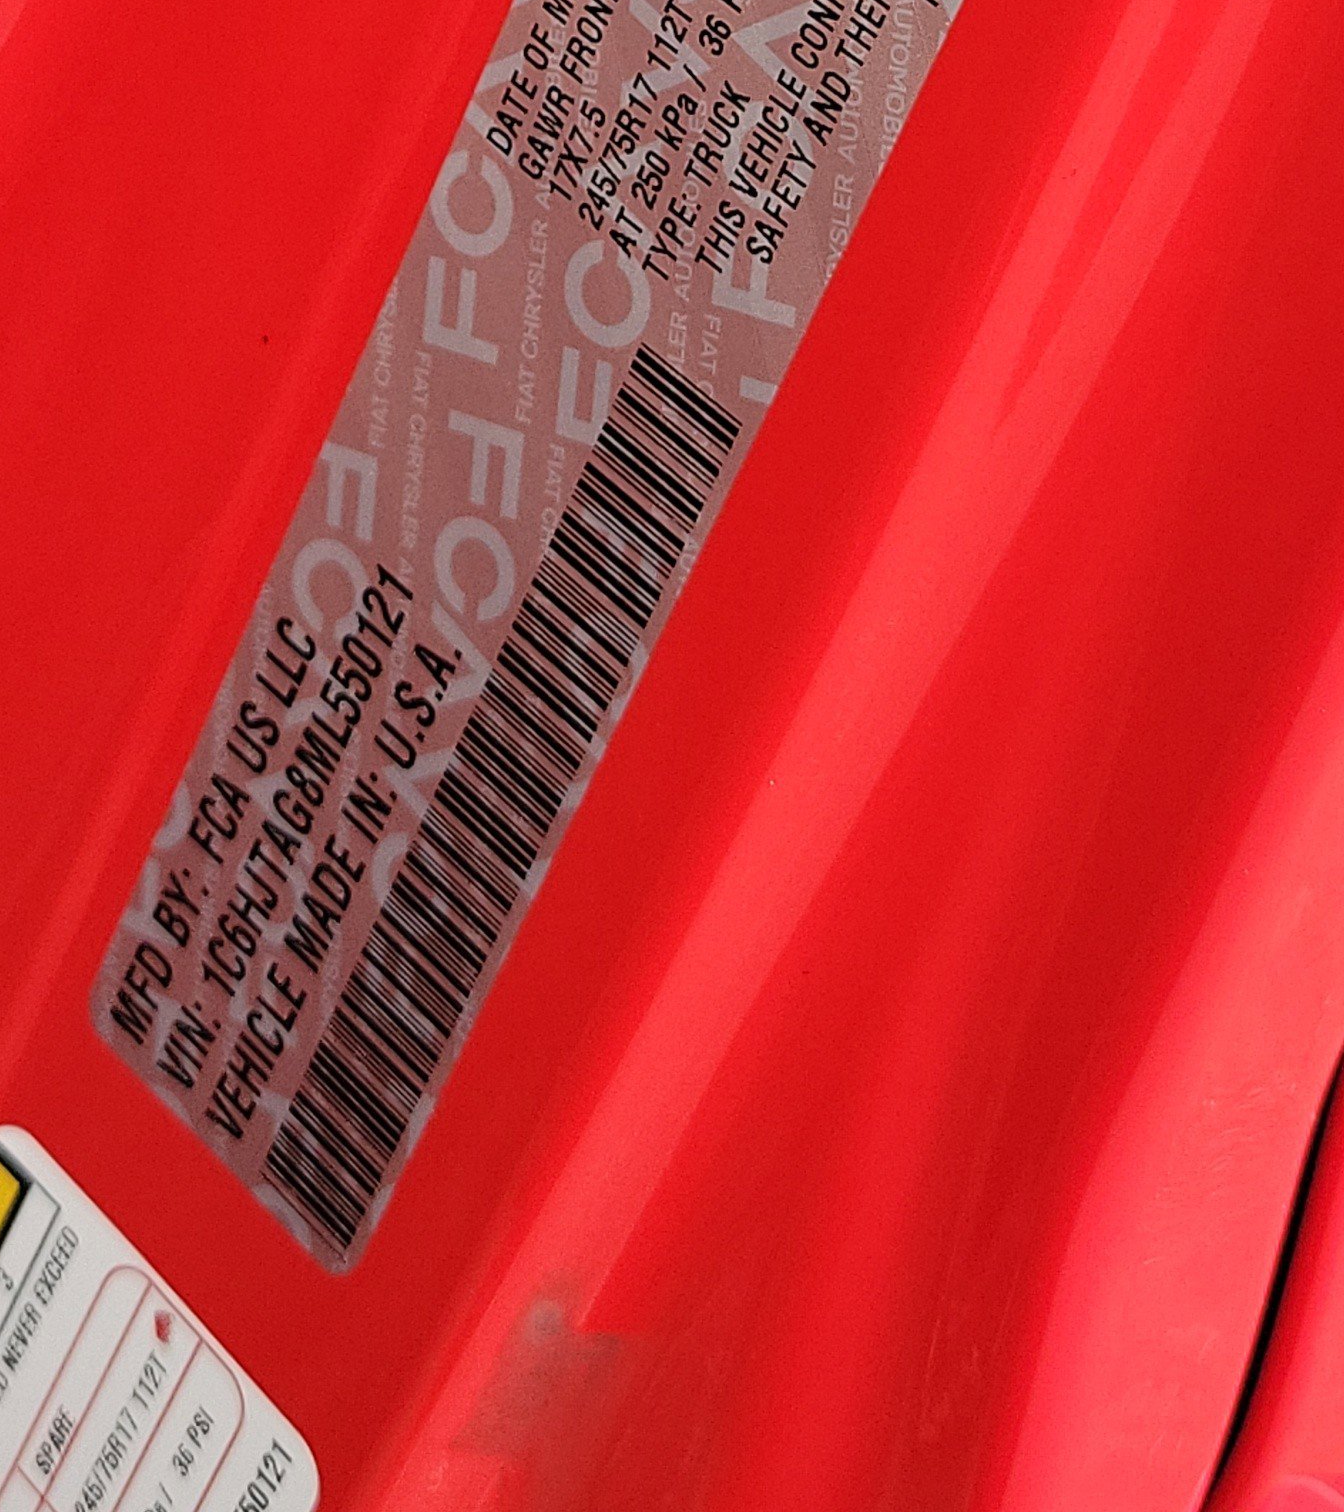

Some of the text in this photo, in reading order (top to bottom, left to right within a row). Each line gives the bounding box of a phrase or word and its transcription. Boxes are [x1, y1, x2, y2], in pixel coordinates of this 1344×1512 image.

[485, 69, 539, 157] DATE
[522, 22, 556, 72] OF
[517, 84, 576, 181] GAWR
[548, 99, 606, 202] 17X7.5
[577, 71, 659, 232] 245/75R17
[608, 205, 643, 259] AT
[630, 150, 671, 211] 250
[653, 92, 699, 152] kPa
[682, 63, 707, 93] /
[698, 13, 733, 57] 36
[693, 199, 746, 274] THIS
[727, 68, 808, 199] VEHICLE
[745, 139, 818, 265] SAFETY
[802, 70, 852, 147] AND
[641, 192, 703, 282] TYPE:
[682, 79, 752, 188] TRUCK
[109, 939, 174, 1046] MFD
[152, 867, 210, 950] BY:
[186, 772, 251, 868] FCA
[225, 699, 281, 776] US
[255, 615, 317, 709] LLC
[156, 562, 414, 1091] VIN: 1C6HJTAG8ML550121
[203, 642, 463, 1143] VEHICLE MADE IN: U.S.A.
[2, 1303, 43, 1373] NEVER
[35, 1225, 80, 1311] EXCEED
[132, 1348, 168, 1412] 112T
[172, 1443, 195, 1478] 36
[186, 1404, 216, 1451] PSI
